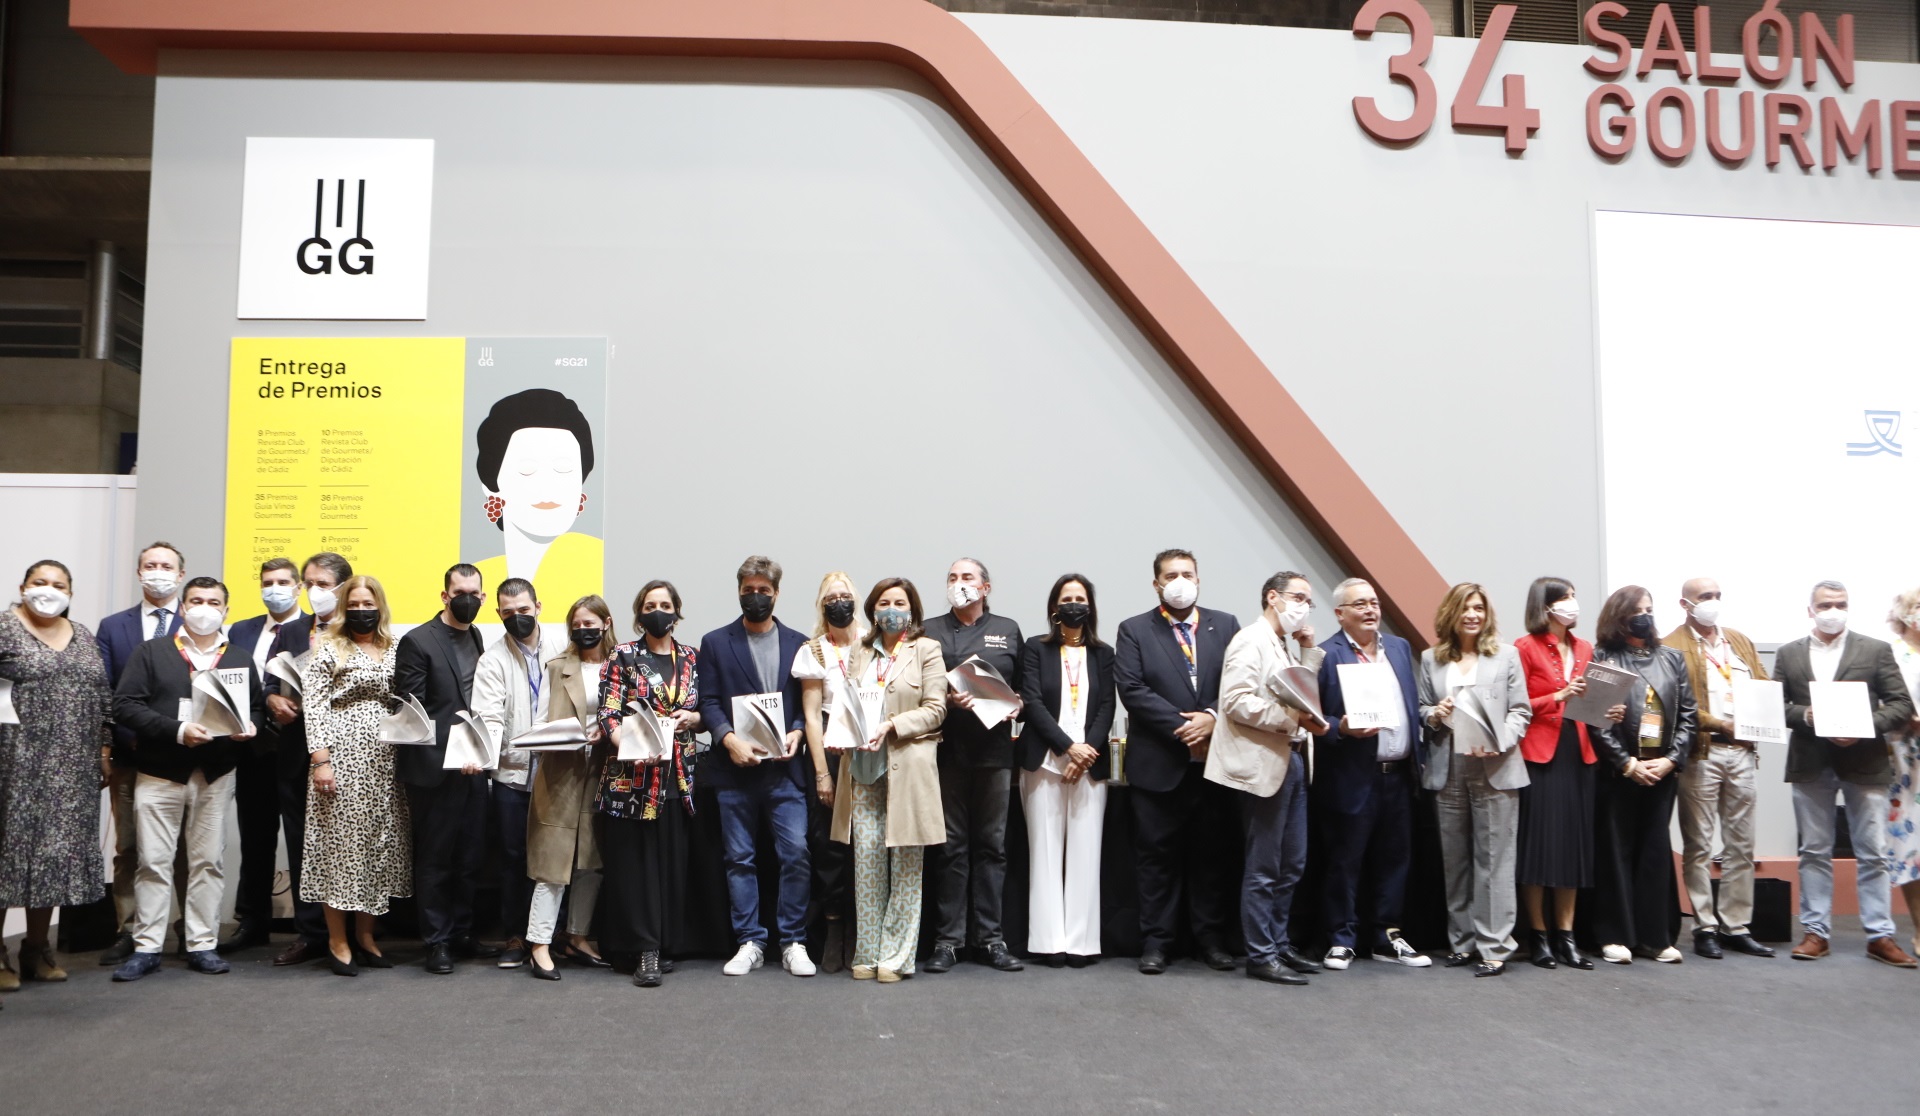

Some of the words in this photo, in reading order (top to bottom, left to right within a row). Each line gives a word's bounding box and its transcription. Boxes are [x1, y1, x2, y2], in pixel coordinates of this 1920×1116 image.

[1583, 0, 1854, 87] SALÓN
[1352, 0, 1540, 152] 34
[1586, 84, 1920, 175] GOURME
[554, 357, 588, 367] #SG21
[260, 358, 347, 379] Entrega
[258, 381, 285, 398] de
[292, 381, 382, 398] Premios
[265, 429, 296, 437] Premios
[258, 438, 286, 446] Revista
[287, 438, 305, 446] Club
[255, 493, 265, 501] 35
[267, 493, 298, 501] Premios
[321, 494, 331, 502] 36
[333, 494, 364, 502] Premios
[273, 502, 296, 510] Vinos
[339, 503, 362, 511] Vinos
[254, 511, 292, 519] Gourmets
[320, 512, 359, 520] Gourmets
[253, 536, 259, 544] 7
[260, 536, 292, 544] Premios
[328, 535, 360, 543] Premios
[253, 545, 270, 554] Liga
